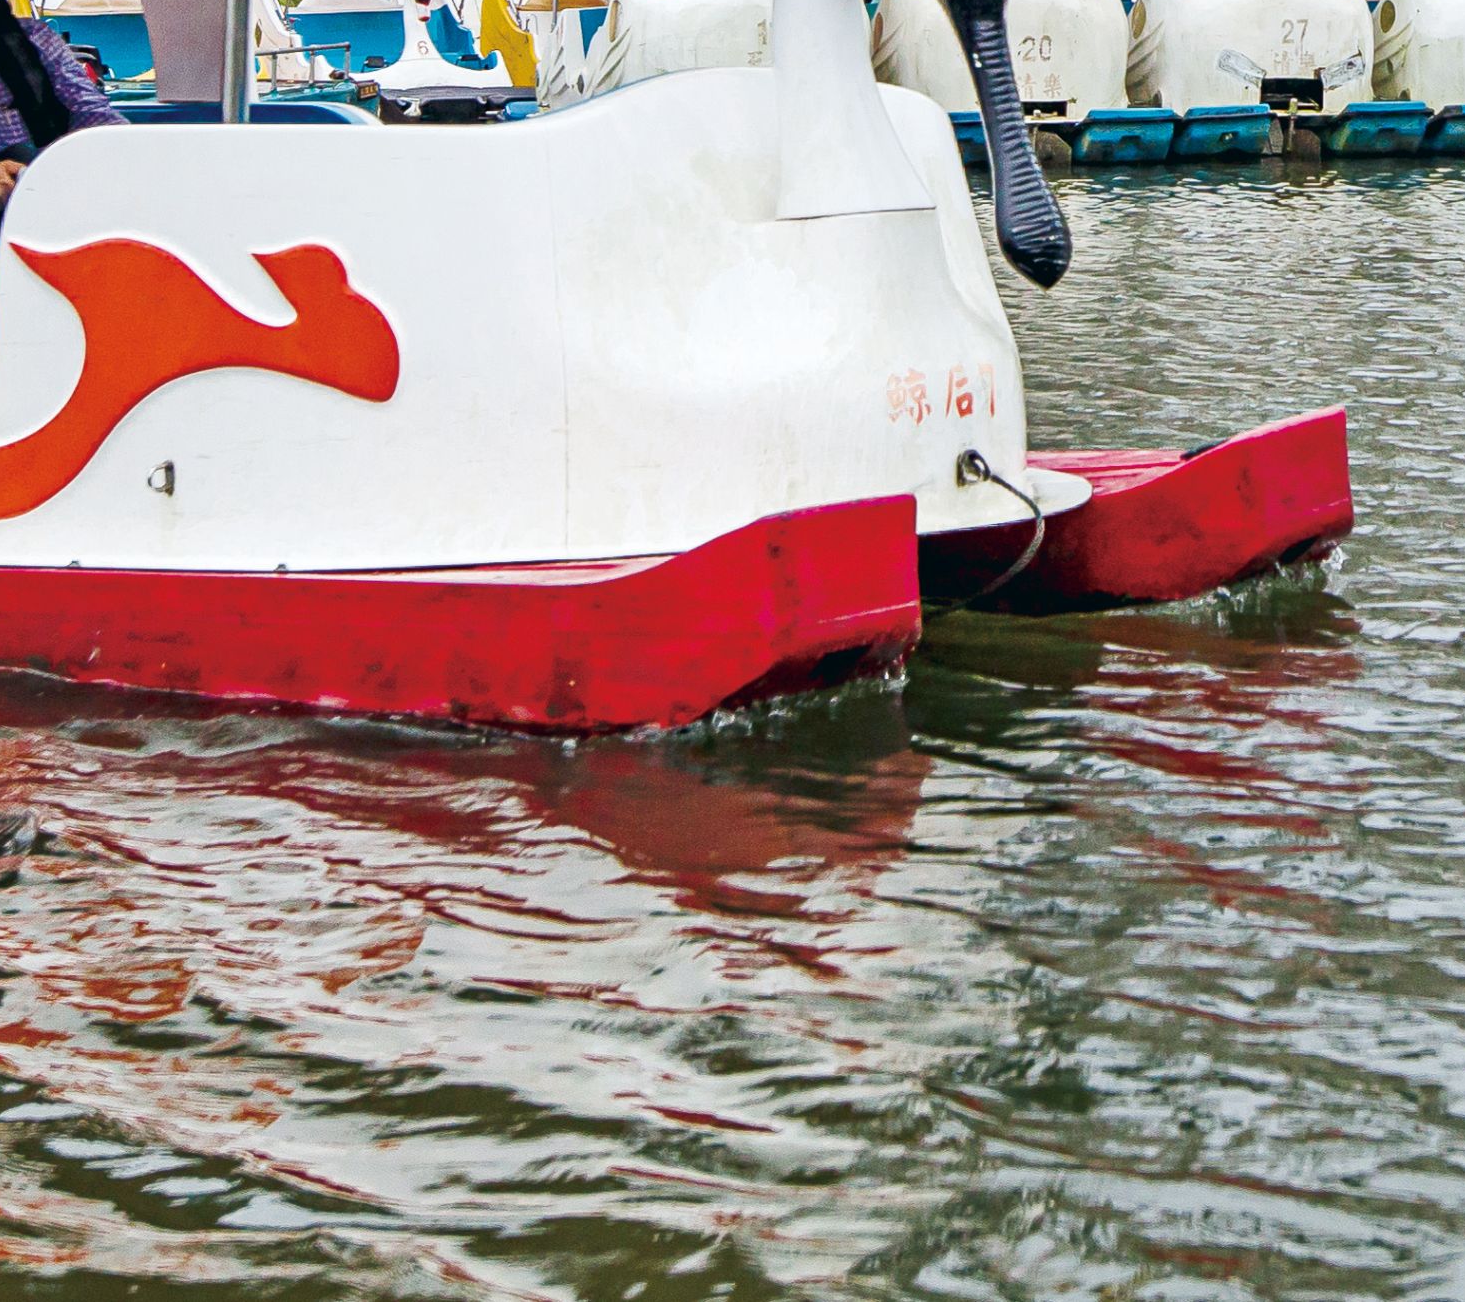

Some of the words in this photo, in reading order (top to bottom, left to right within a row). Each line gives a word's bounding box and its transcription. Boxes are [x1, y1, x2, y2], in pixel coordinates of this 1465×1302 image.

[1281, 19, 1309, 44] 27
[417, 40, 429, 55] 6
[1018, 35, 1052, 62] 20
